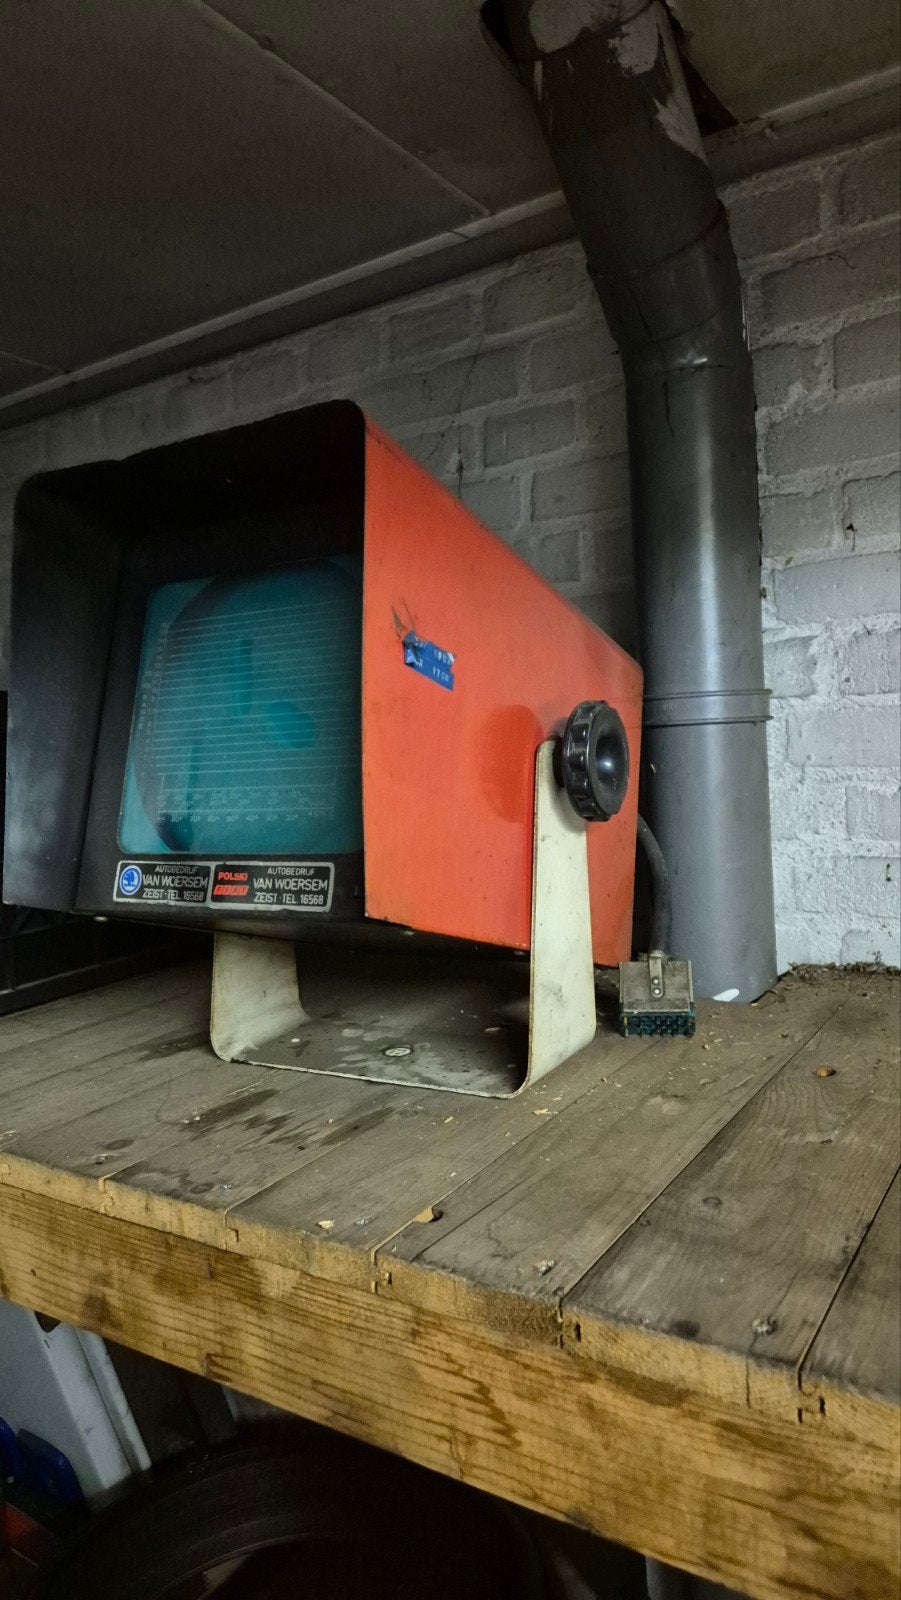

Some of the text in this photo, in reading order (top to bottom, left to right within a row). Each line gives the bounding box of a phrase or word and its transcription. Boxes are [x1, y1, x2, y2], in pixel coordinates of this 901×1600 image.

[154, 864, 200, 875] AUTOBEDRIJF
[266, 866, 315, 877] AUTOBEDRIJF
[142, 873, 209, 889] VAN WOERSEM
[217, 871, 249, 881] POLSKI
[252, 877, 328, 891] VAN WOERSEM
[183, 891, 205, 901] 16568
[253, 891, 278, 903] ZEIST
[299, 894, 324, 906] 16568
